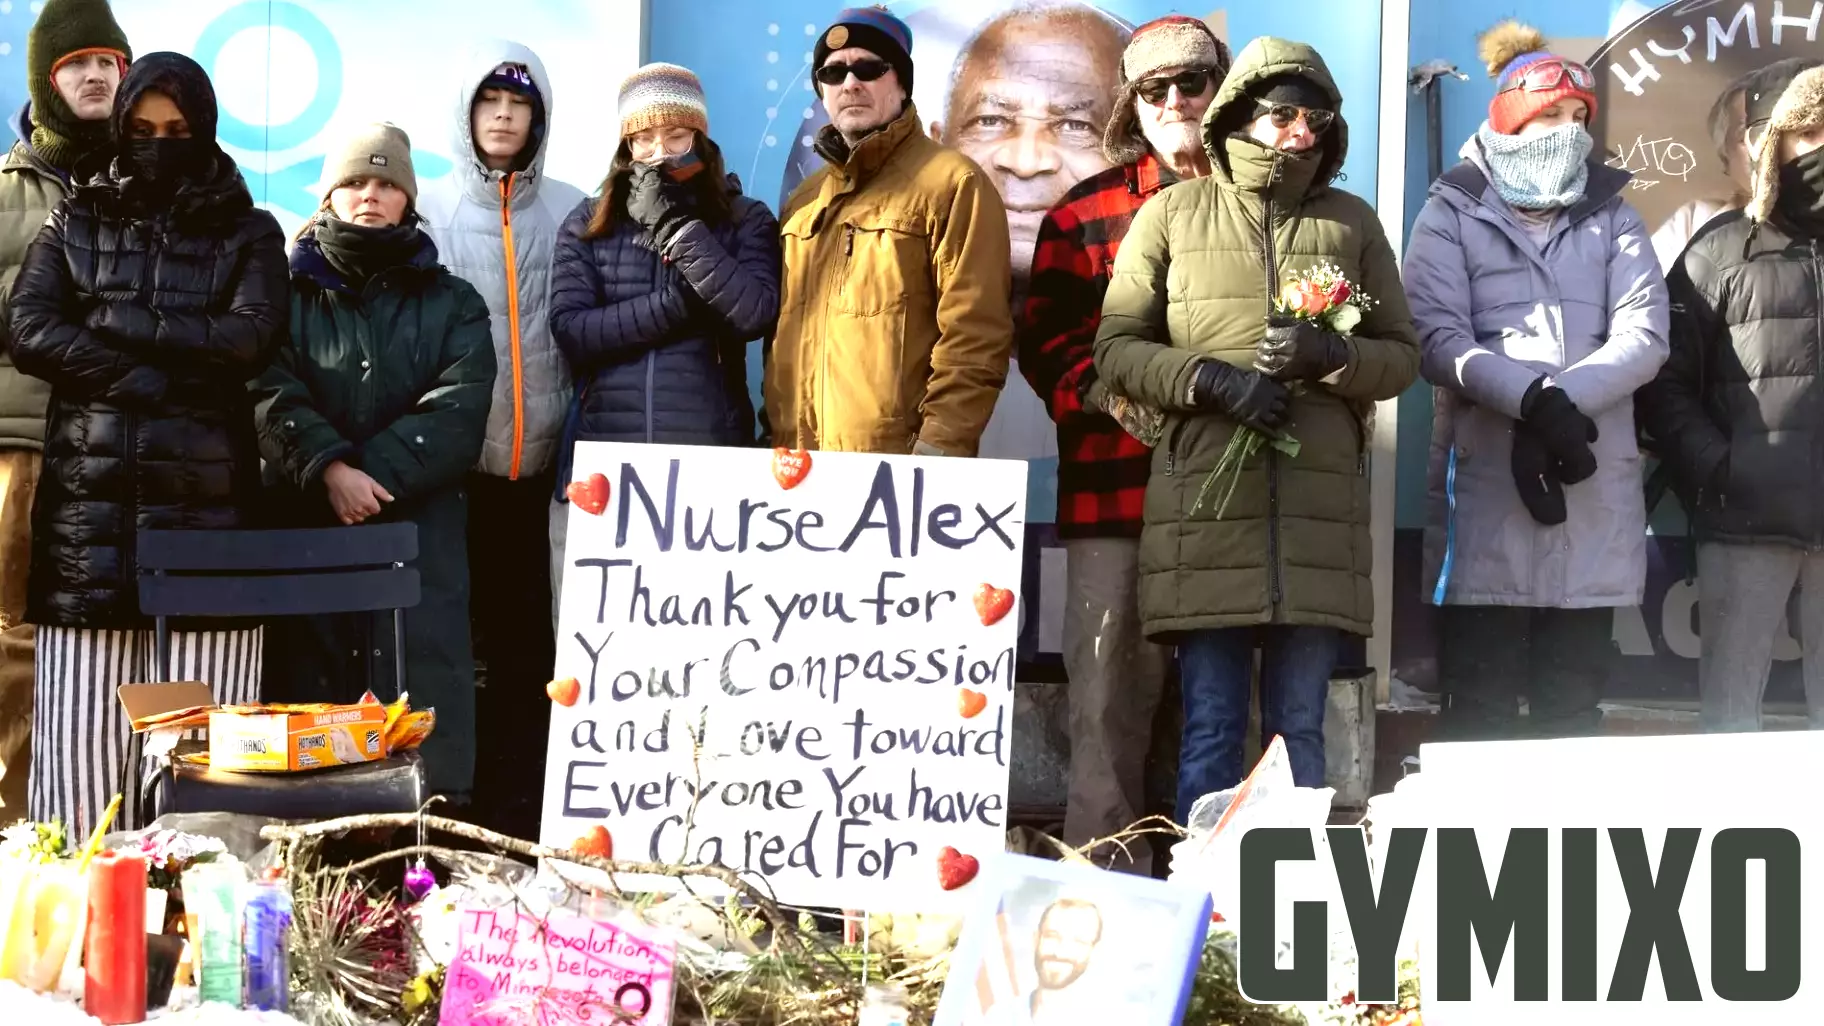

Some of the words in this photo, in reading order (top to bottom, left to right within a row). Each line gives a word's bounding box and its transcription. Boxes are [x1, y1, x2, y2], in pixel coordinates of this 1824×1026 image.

[615, 459, 837, 554] Nurse
[574, 558, 754, 627] Thank
[764, 588, 857, 643] you
[859, 571, 957, 625] for
[574, 631, 709, 704] Your
[570, 707, 672, 754] and
[842, 705, 1005, 766] toward
[562, 760, 806, 819] Everyone
[822, 766, 899, 820] You
[908, 768, 1004, 827] have
[649, 810, 823, 878] Cared
[835, 818, 917, 880] For
[461, 942, 538, 974] always
[464, 908, 518, 944] The
[456, 964, 480, 991] to
